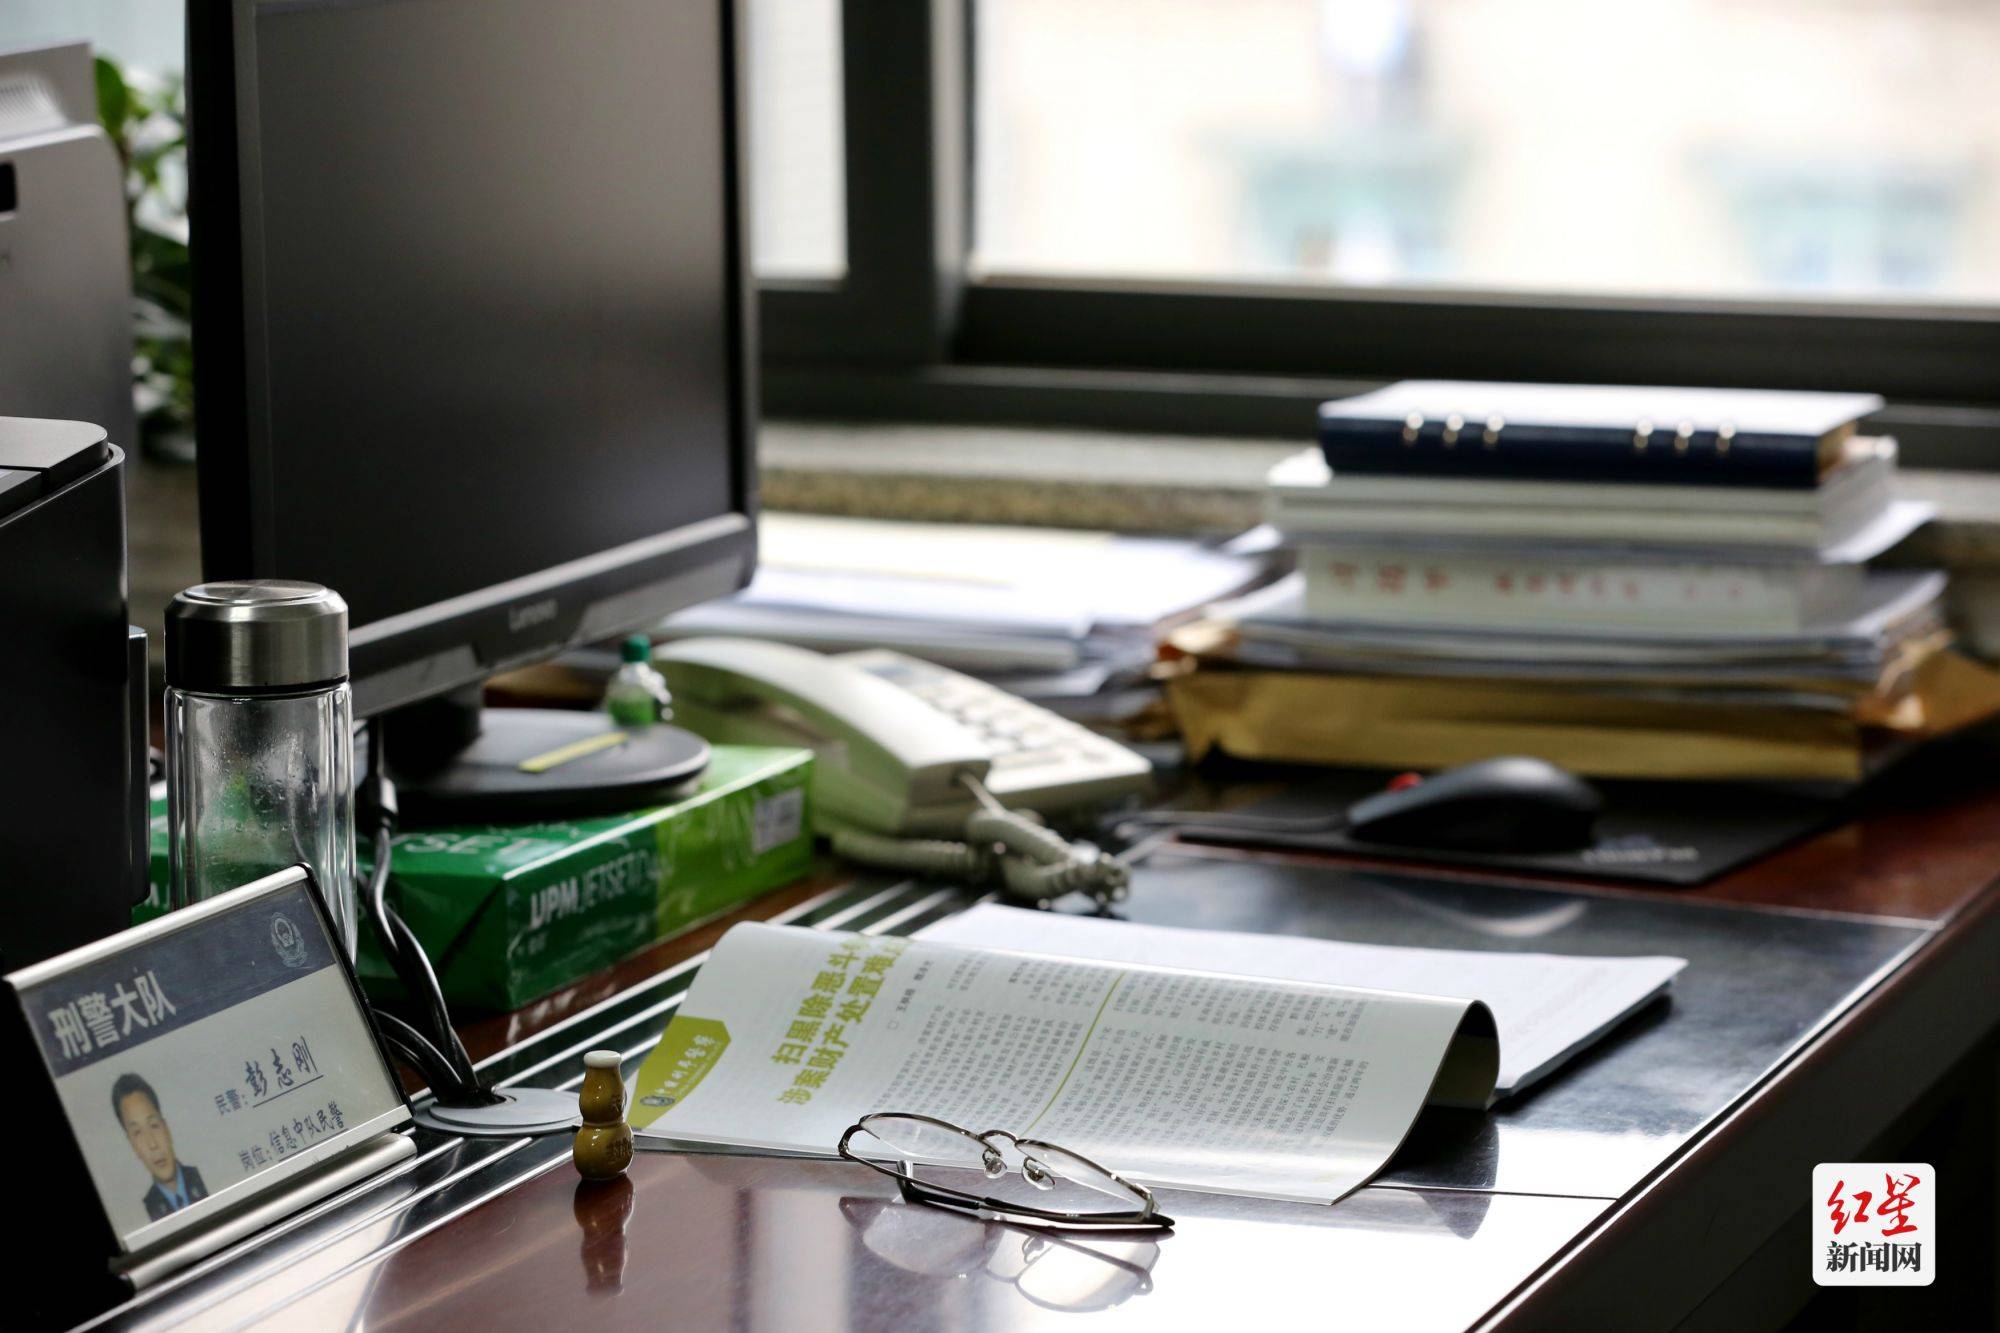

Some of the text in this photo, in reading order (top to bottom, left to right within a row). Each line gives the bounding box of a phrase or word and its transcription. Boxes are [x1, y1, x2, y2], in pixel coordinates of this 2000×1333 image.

[48, 970, 177, 1060] 刑警大队
[244, 1036, 318, 1097] 彭志刚
[268, 1100, 343, 1154] 信息中队民警
